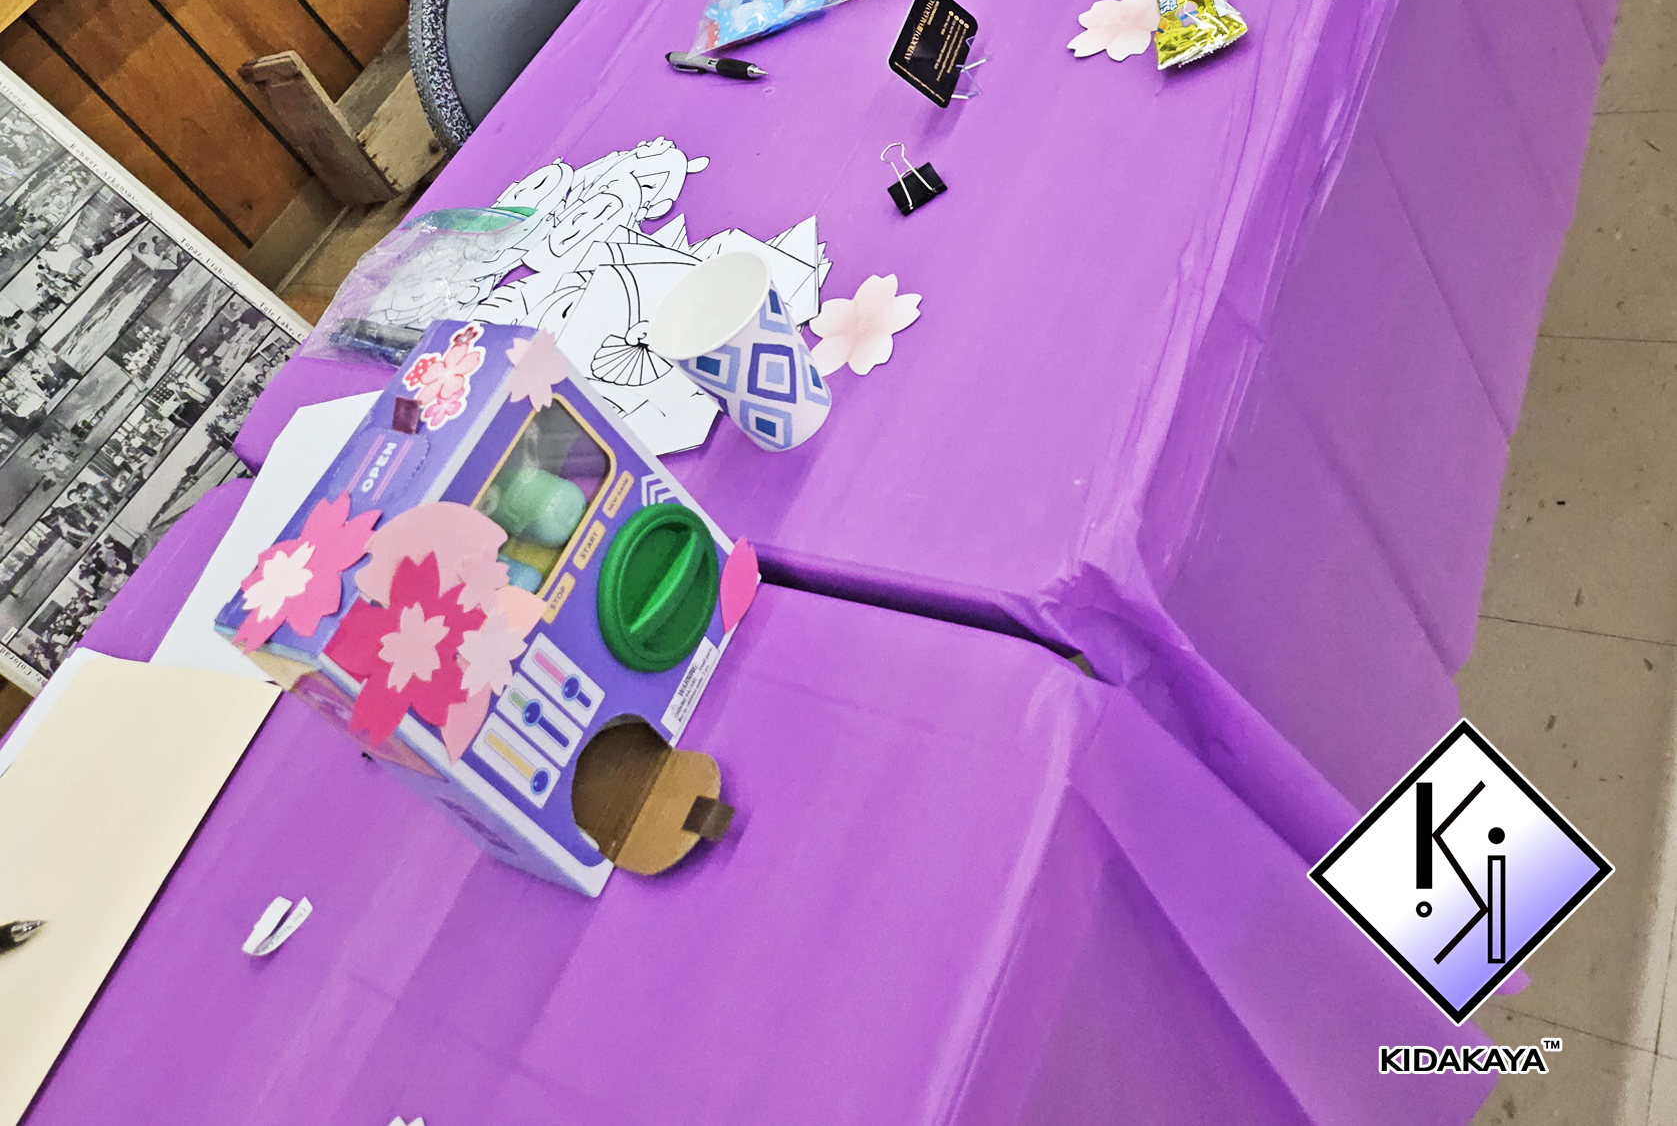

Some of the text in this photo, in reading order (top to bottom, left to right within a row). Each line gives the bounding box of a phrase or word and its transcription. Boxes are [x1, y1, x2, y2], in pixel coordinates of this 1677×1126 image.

[69, 143, 99, 172] Rohwer,
[181, 238, 203, 260] Topaz,
[260, 302, 275, 316] Tule
[276, 316, 295, 335] Lake,
[361, 442, 397, 492] OPEN
[607, 497, 619, 512] NEW
[580, 531, 599, 560] START
[550, 585, 566, 611] STOP
